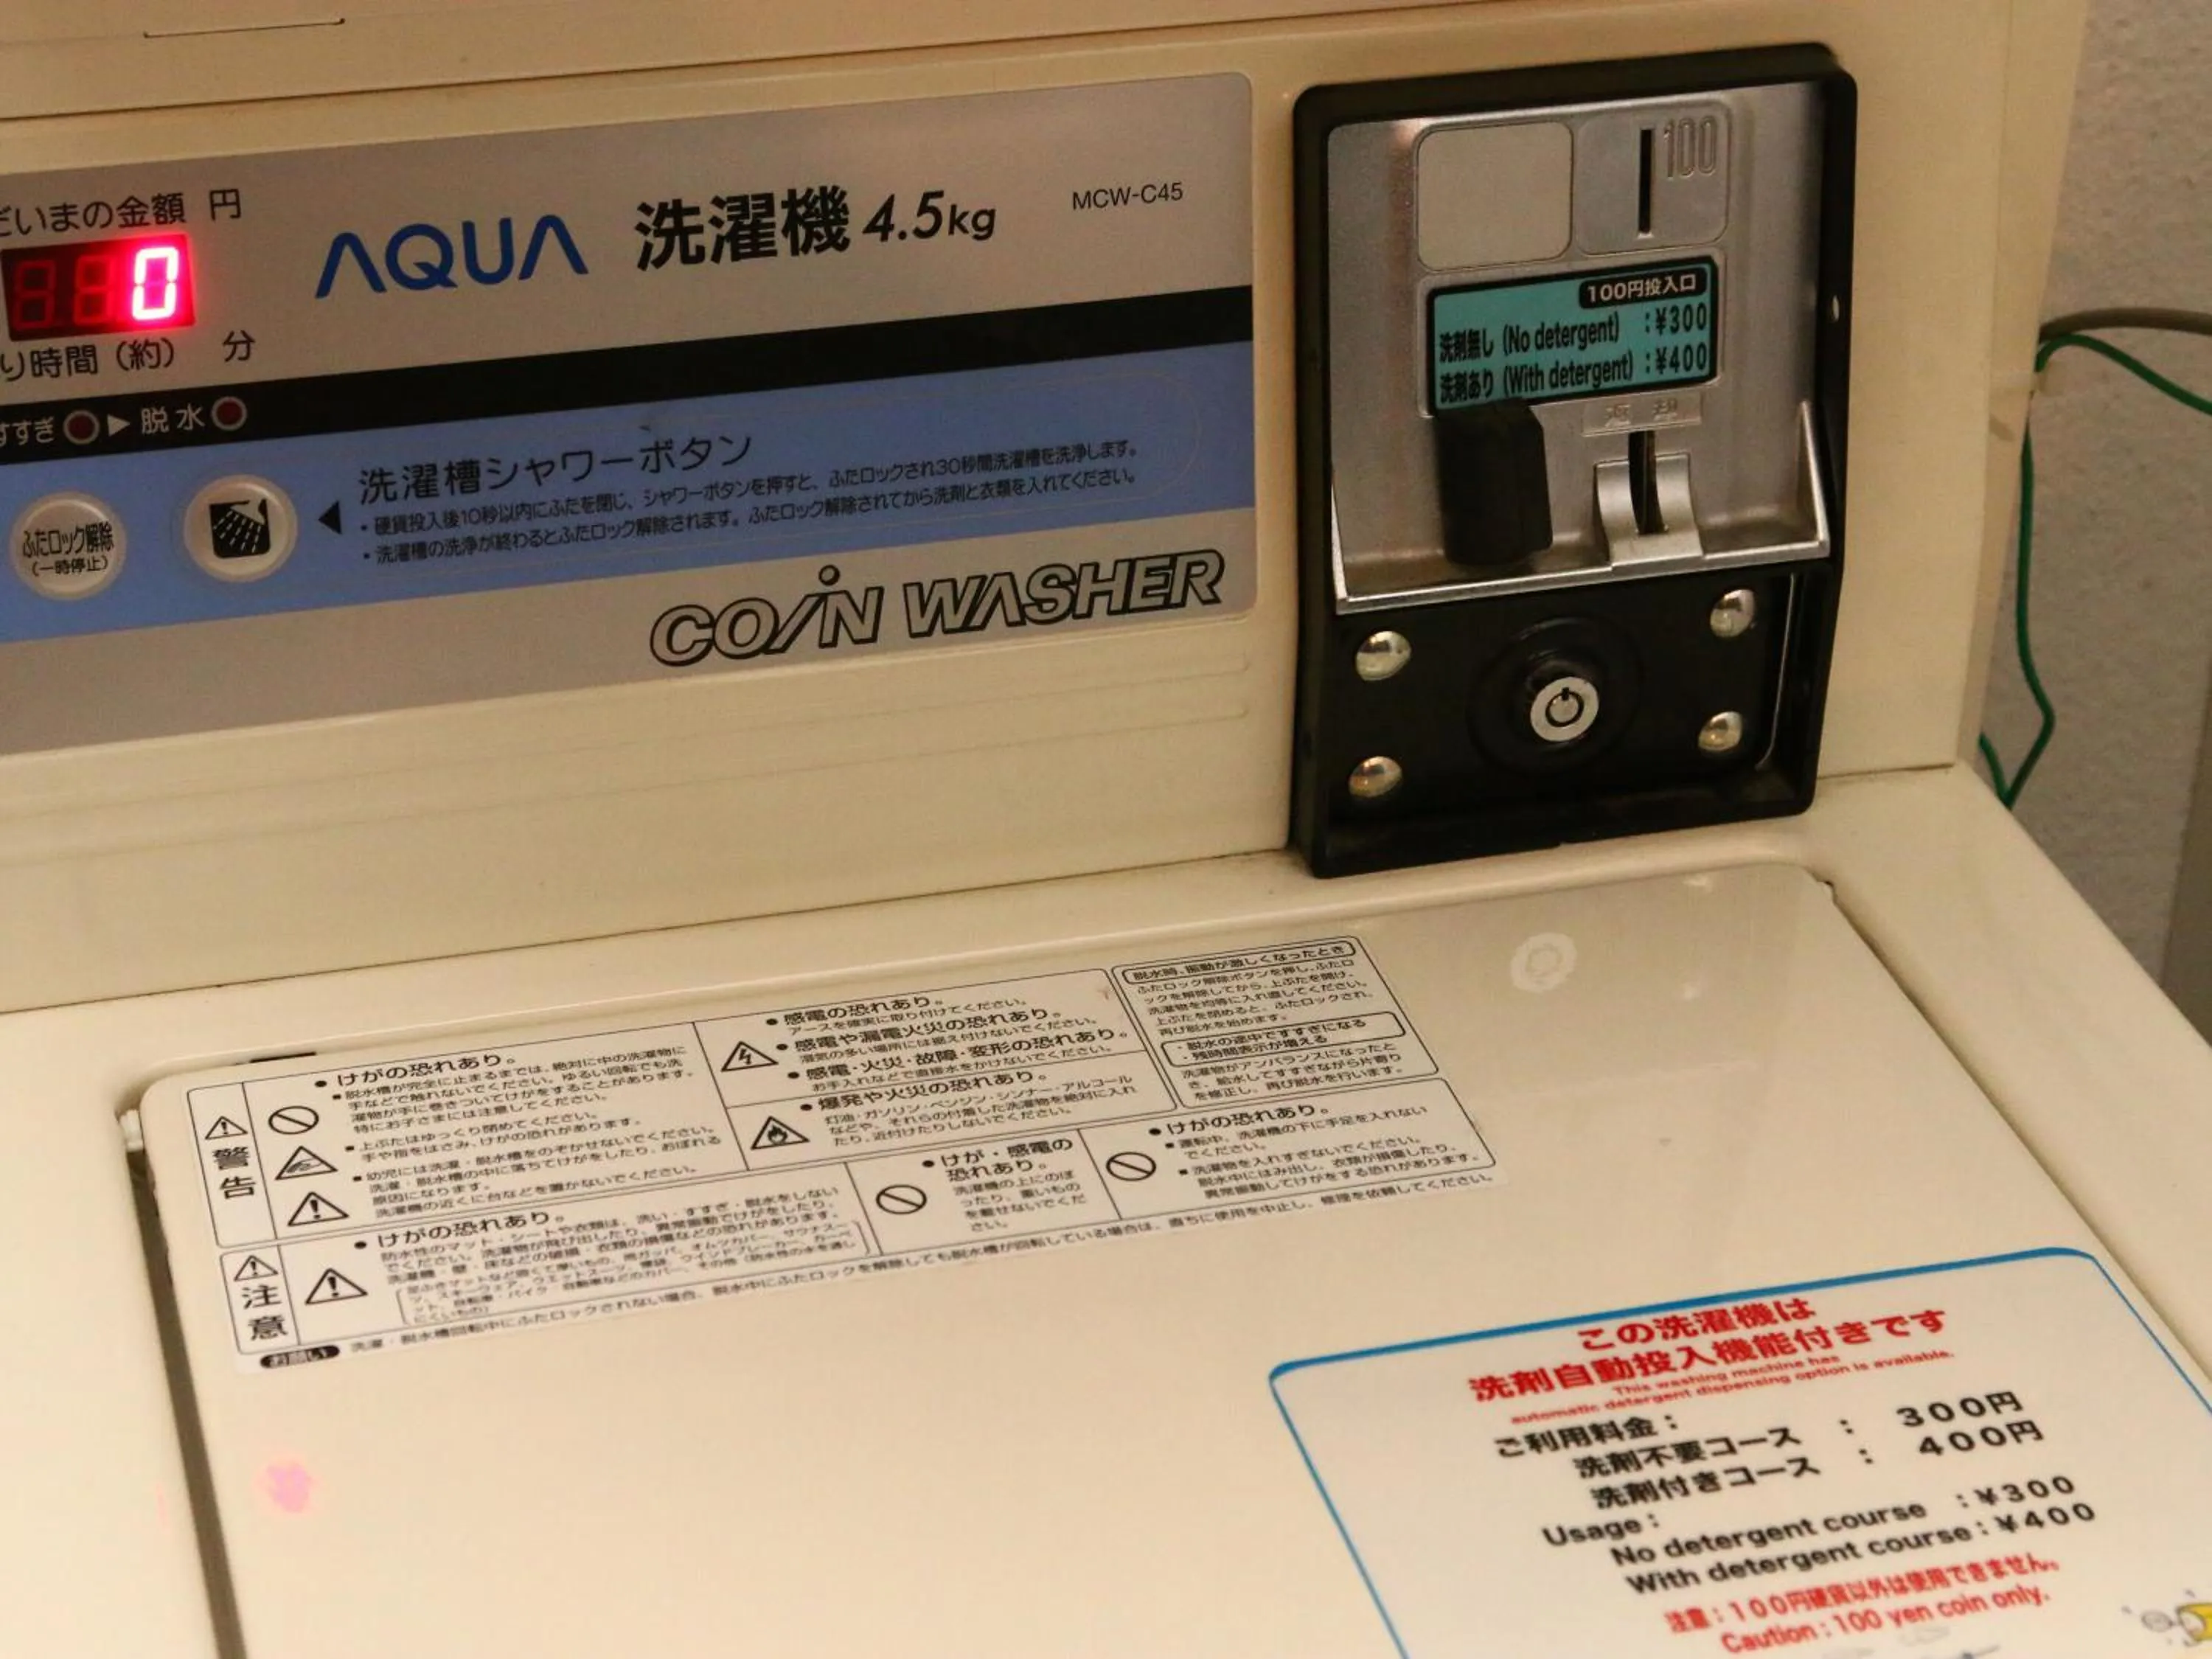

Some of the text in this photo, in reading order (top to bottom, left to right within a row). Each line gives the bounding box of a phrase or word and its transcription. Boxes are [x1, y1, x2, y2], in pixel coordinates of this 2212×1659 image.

[1663, 116, 1718, 180] 100
[209, 189, 241, 220] 円
[1072, 182, 1184, 211] MCW-C45
[634, 186, 996, 271] 洗濯機 4.5kg
[131, 246, 179, 320] 0
[315, 215, 588, 299] AQUA
[1587, 273, 1696, 303] 100円投入口
[223, 330, 255, 363] 分
[1439, 327, 1494, 364] 洗剤無し
[1503, 323, 1530, 356] (No
[1534, 310, 1619, 350] detergent)
[1440, 372, 1494, 405] 洗剤あり
[1504, 364, 1545, 399] (With
[1549, 349, 1634, 389] detergent)
[359, 435, 751, 505] 洗濯槽シャワーボタン
[22, 521, 114, 559] ふたロック解除
[650, 549, 1225, 667] COIN WASHER
[782, 993, 944, 1025] 感電の恐れあり。
[793, 1005, 1062, 1051] 感電や漏電火災の恐れあり。
[335, 1051, 516, 1086] けがの恐れあり。
[805, 1025, 1128, 1080] 感電・火災・故障・変形の恐れあり。
[817, 1067, 1048, 1110] 爆発や火災の恐れあり。
[1165, 1100, 1330, 1136] けがの恐れあり。
[212, 1145, 257, 1200] 警告
[939, 1136, 1076, 1168] けが・感電の
[945, 1155, 1048, 1183] 恐れあり。
[376, 1208, 565, 1248] けがの恐れあり。
[240, 1282, 288, 1341] 注意
[1578, 1297, 1816, 1352] この洗濯機は
[1469, 1309, 1947, 1402] 洗剤自動投入機能付きです
[1613, 1354, 1840, 1397] This washing machine has
[1511, 1349, 1955, 1425] automatic detergent dispensing option is available.
[1573, 1427, 1802, 1479] 洗剤不要コース
[1896, 1391, 2023, 1427] 300円
[1590, 1456, 1821, 1509] 洗剤付きコース
[1919, 1419, 2044, 1456] 400円
[1610, 1545, 1657, 1567] No
[1663, 1518, 1818, 1560] detergent
[1823, 1503, 1927, 1533] course
[1625, 1567, 1702, 1596] With
[1708, 1541, 1862, 1583] detergent
[1888, 1601, 1933, 1628] yen
[1937, 1593, 1989, 1618] coin
[1992, 1582, 2051, 1609] only.
